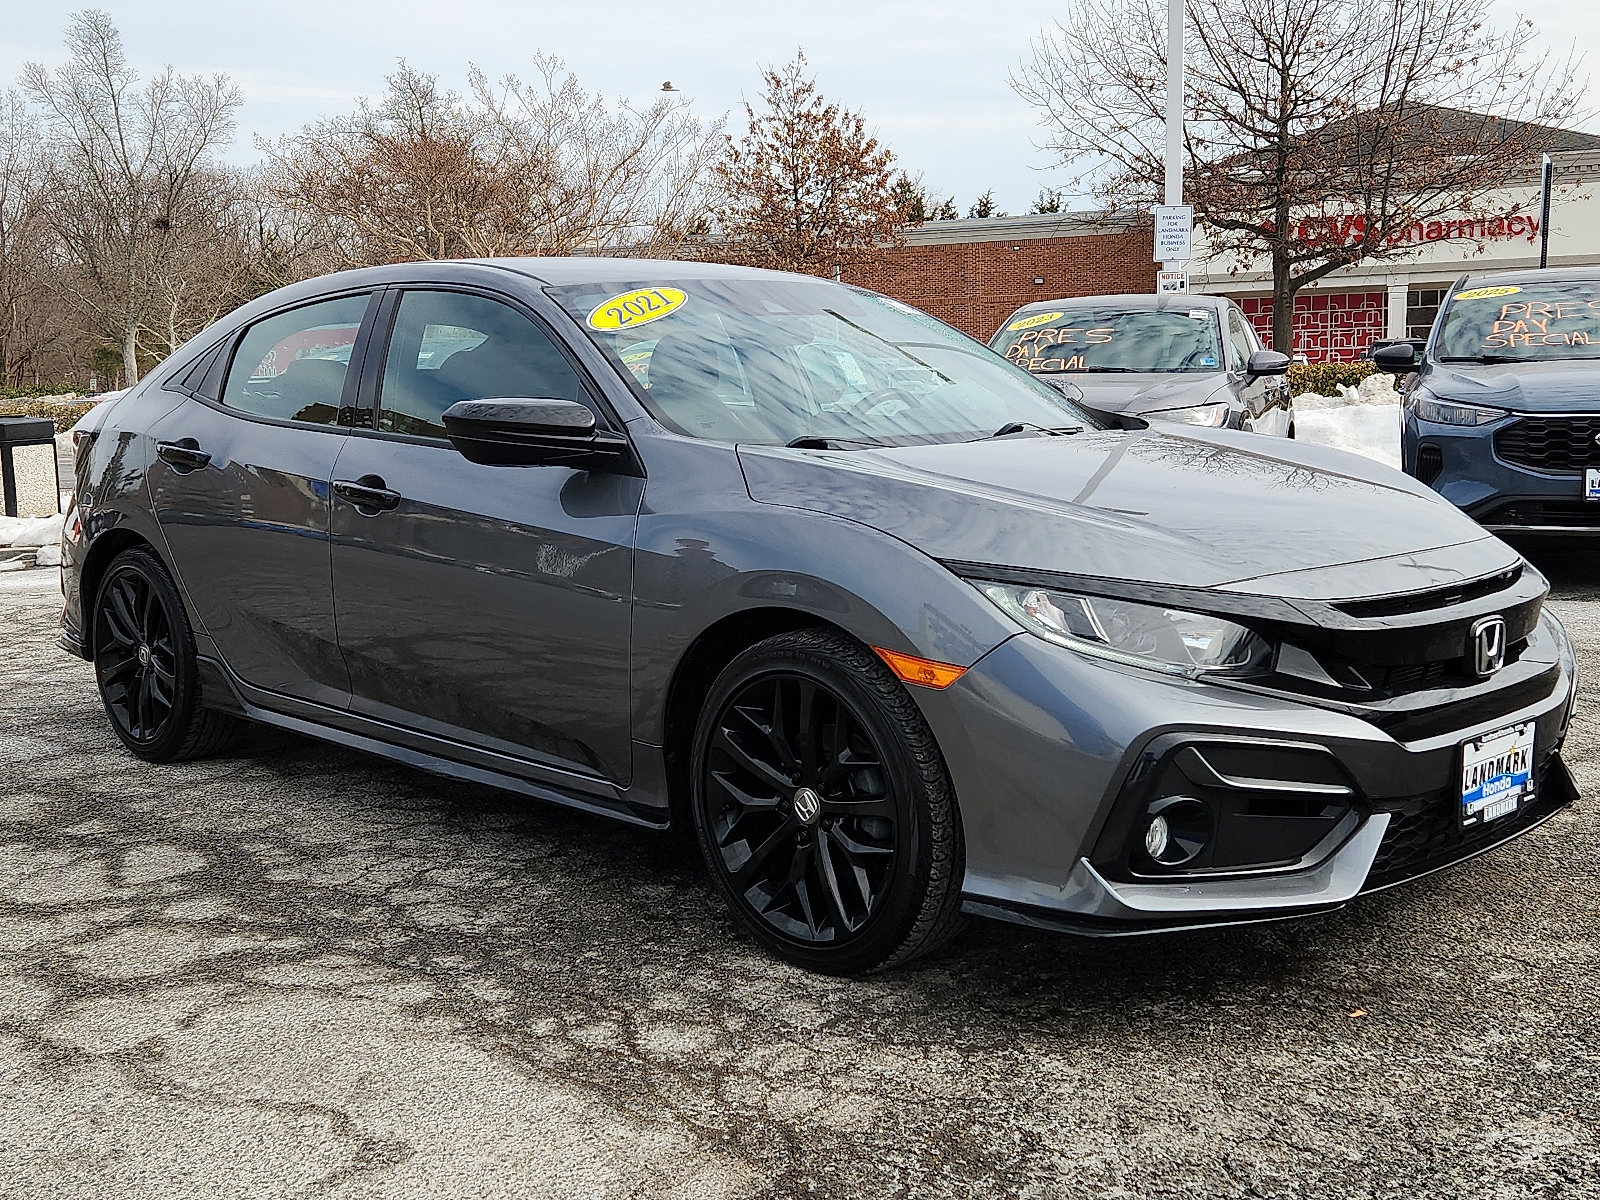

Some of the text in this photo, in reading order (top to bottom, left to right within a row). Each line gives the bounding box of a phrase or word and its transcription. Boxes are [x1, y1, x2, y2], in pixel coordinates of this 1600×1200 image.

[1386, 215, 1540, 248] pharmacy
[1465, 287, 1511, 299] 2025
[606, 289, 674, 325] 2021
[1492, 318, 1548, 334] DAY
[1018, 328, 1116, 345] PRES
[1481, 331, 1600, 348] SPECIAL
[1004, 343, 1048, 359] DAY
[1465, 748, 1529, 791] LANDMARK
[1482, 776, 1512, 798] Honda
